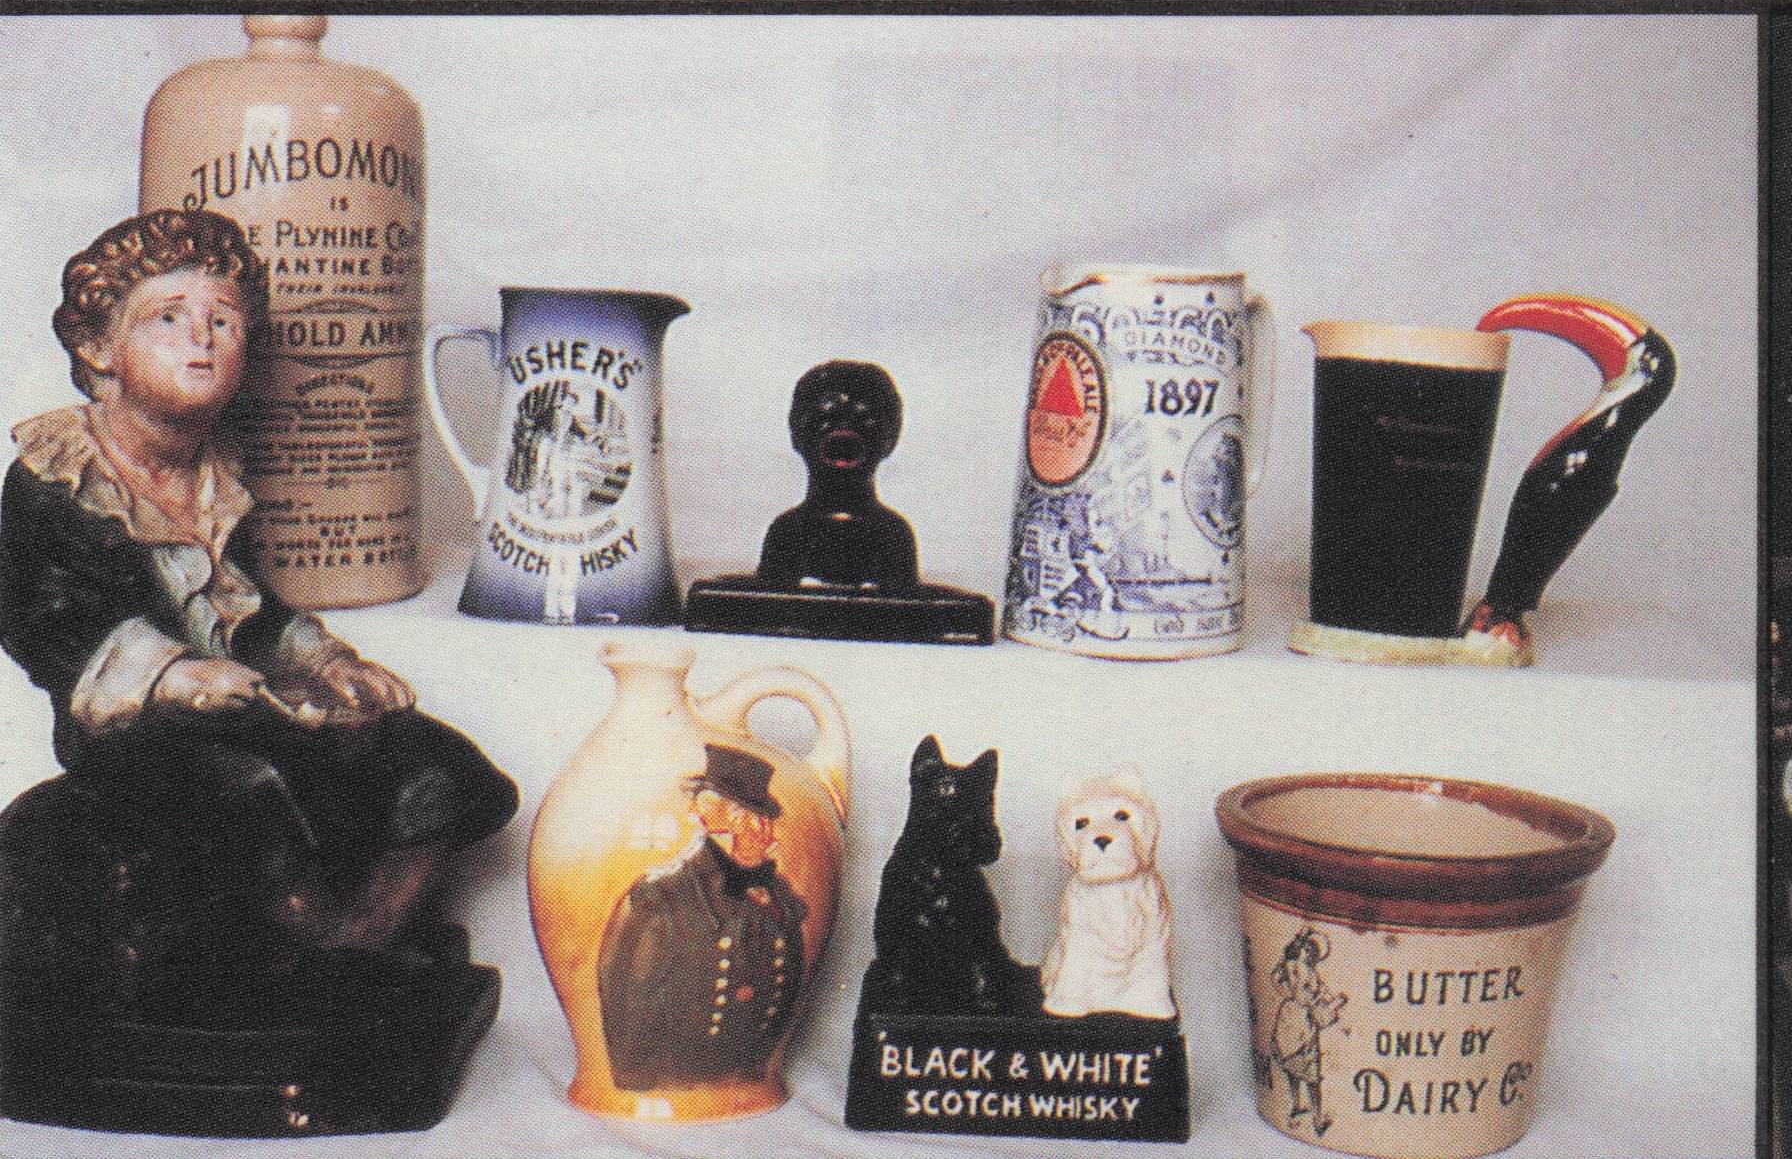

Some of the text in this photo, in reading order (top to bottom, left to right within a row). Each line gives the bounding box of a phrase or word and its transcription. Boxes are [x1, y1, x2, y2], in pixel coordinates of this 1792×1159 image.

[1124, 329, 1228, 366] DIAMOND
[1145, 377, 1222, 418] 1897
[488, 520, 551, 576] SCOTCH
[1373, 965, 1524, 1005] BUTTER
[1376, 1025, 1495, 1057] ONLY BY
[1008, 1053, 1029, 1080] &
[903, 1089, 1141, 1123] SCOTCH WHISKY
[1352, 1067, 1489, 1115] DAIRY
